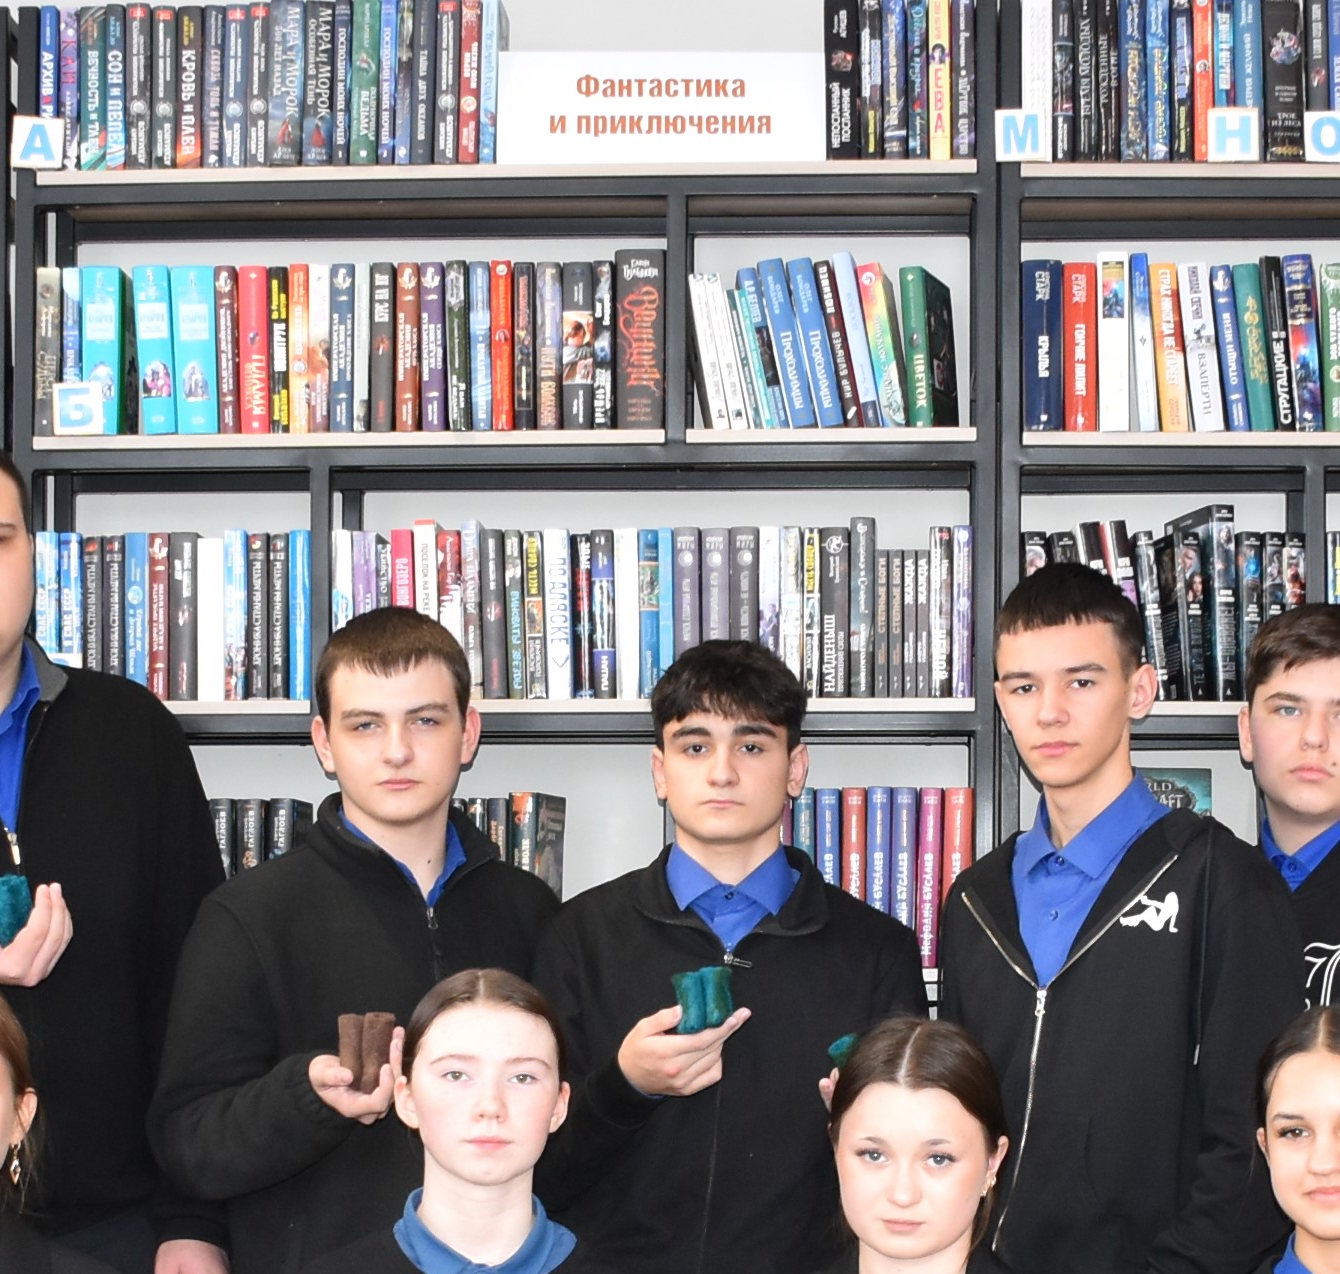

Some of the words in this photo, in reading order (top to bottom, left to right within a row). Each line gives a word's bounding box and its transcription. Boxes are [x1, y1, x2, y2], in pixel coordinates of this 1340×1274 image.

[284, 6, 300, 50] МАРА
[317, 7, 332, 50] МАРА
[108, 50, 122, 82] СОН
[180, 50, 196, 101] КРОВЬ
[284, 62, 300, 119] МОРОК
[306, 79, 317, 105] ТЕНЬ
[317, 63, 332, 119] МОРОК
[576, 74, 747, 98] Фантастика
[549, 117, 567, 134] и
[577, 114, 773, 137] приключения
[830, 82, 842, 148] НЕПОСЛАННЫЙ
[841, 88, 852, 143] ПОСЛАННИК
[934, 68, 946, 134] ЕВА
[20, 124, 55, 160] А
[1004, 114, 1039, 155] М
[1215, 115, 1252, 155] Н
[780, 331, 806, 410] ПРОХОДИМЦЫ
[808, 330, 833, 410] ПРОХОДИМЦЫ
[913, 354, 928, 409] ЦВЕТОК
[1038, 335, 1050, 378] КРЫЛЬЯ
[1271, 340, 1293, 426] СТРУГАЦКИЕ
[60, 388, 94, 426] Б
[252, 354, 265, 416] ПЛАМЯ
[1198, 351, 1213, 416] ВЗАПЕРТИ
[549, 558, 569, 577] ПО
[549, 580, 569, 644] АЛЯСКЕ
[823, 615, 837, 693] НАЙДЕНЫШ
